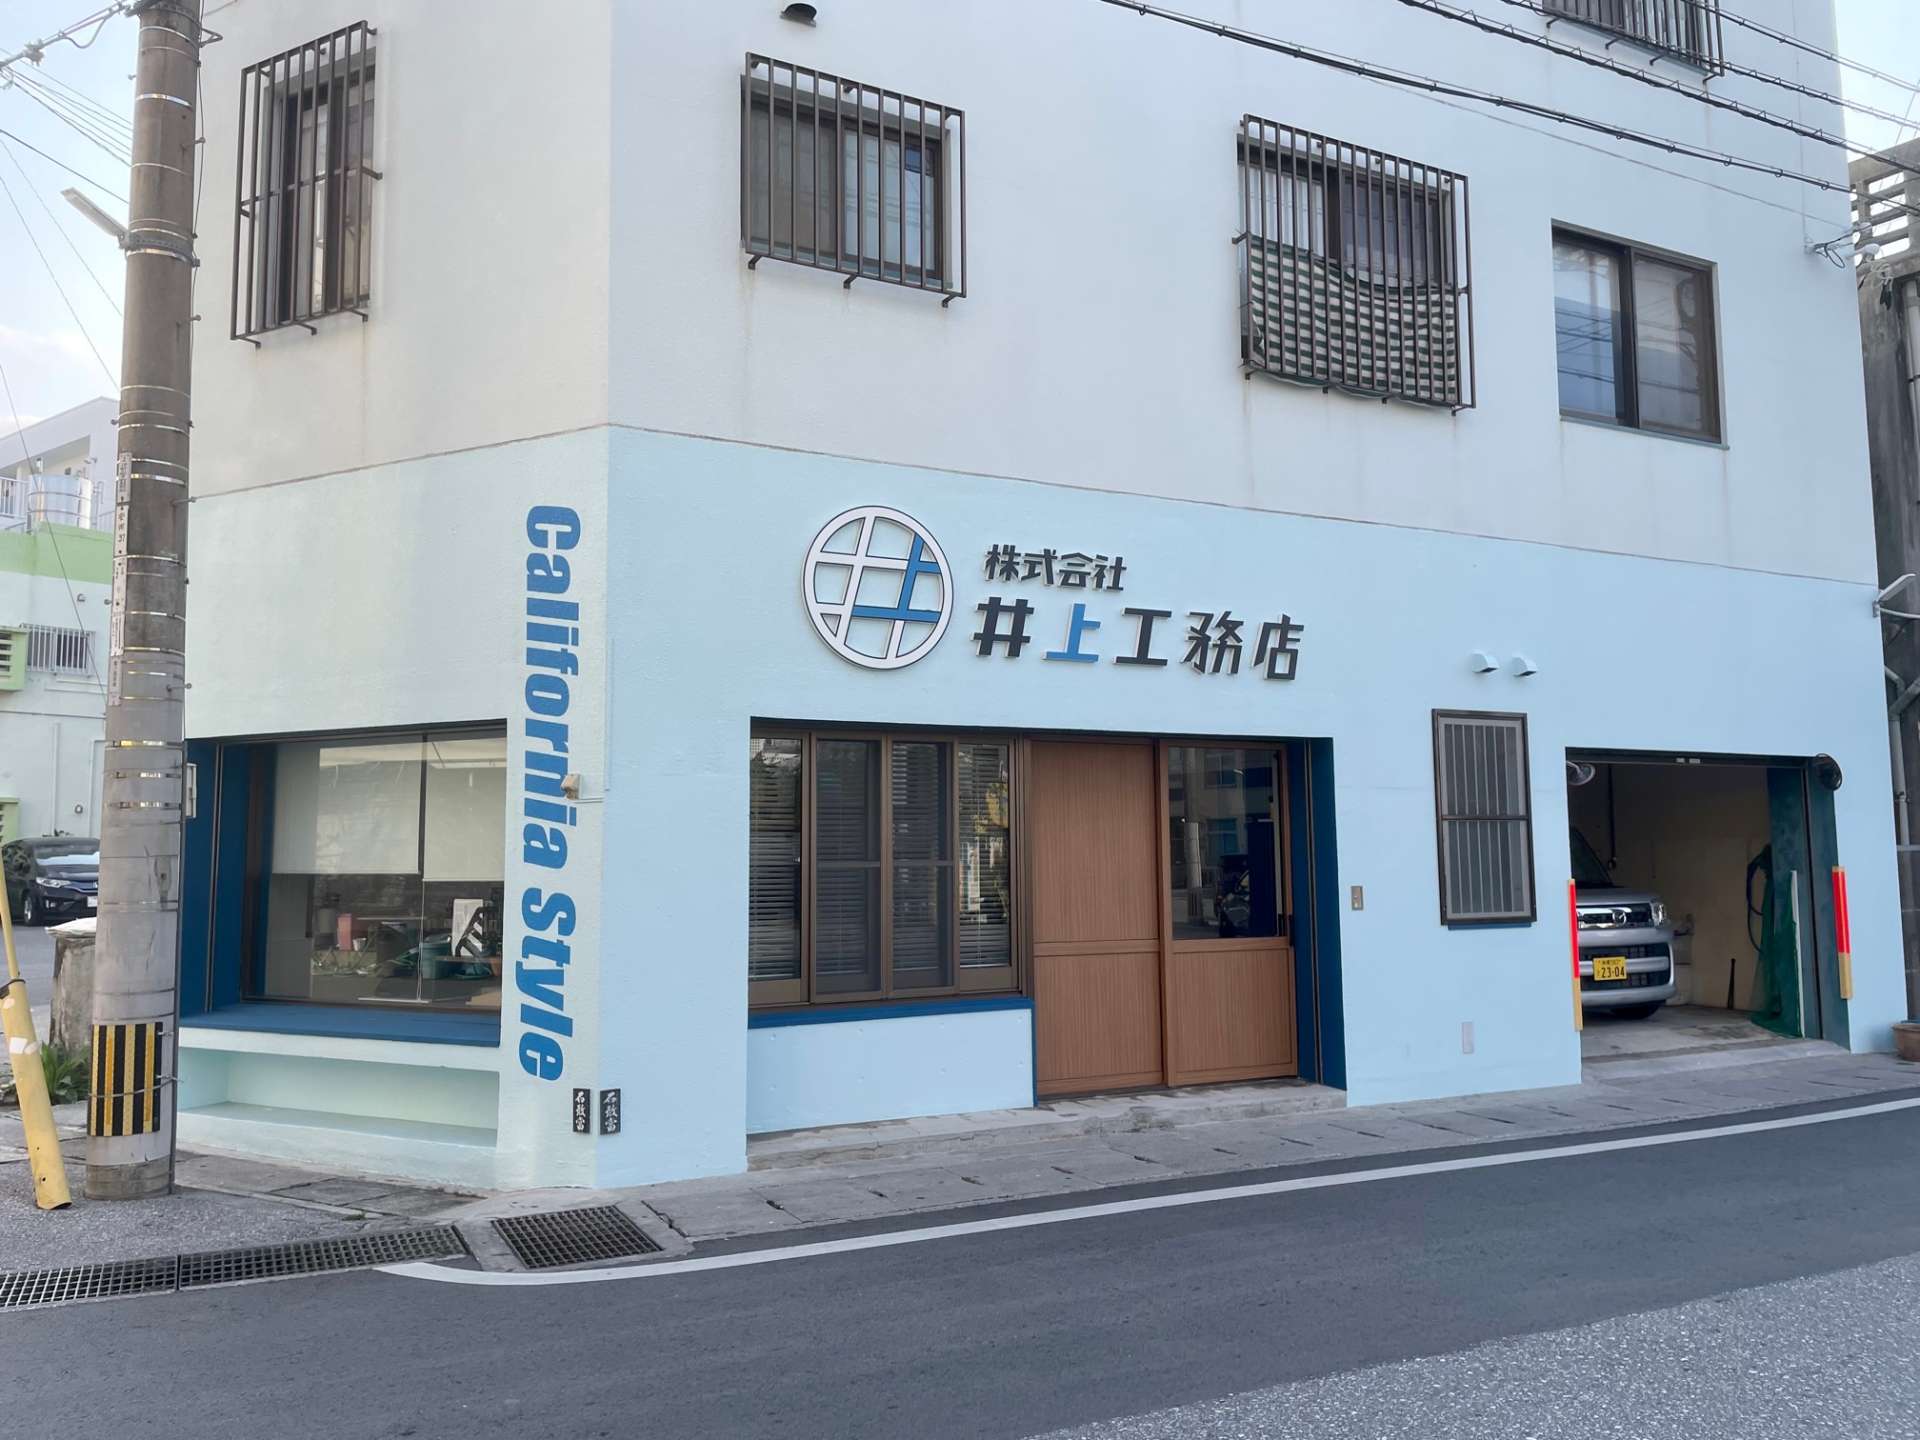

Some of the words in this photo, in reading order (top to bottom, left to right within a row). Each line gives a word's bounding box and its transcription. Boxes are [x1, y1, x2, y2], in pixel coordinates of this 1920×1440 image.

[984, 544, 1128, 591] 株式会社
[523, 506, 580, 870] California
[971, 596, 1306, 682] 井上工務店
[515, 887, 577, 1082] Style
